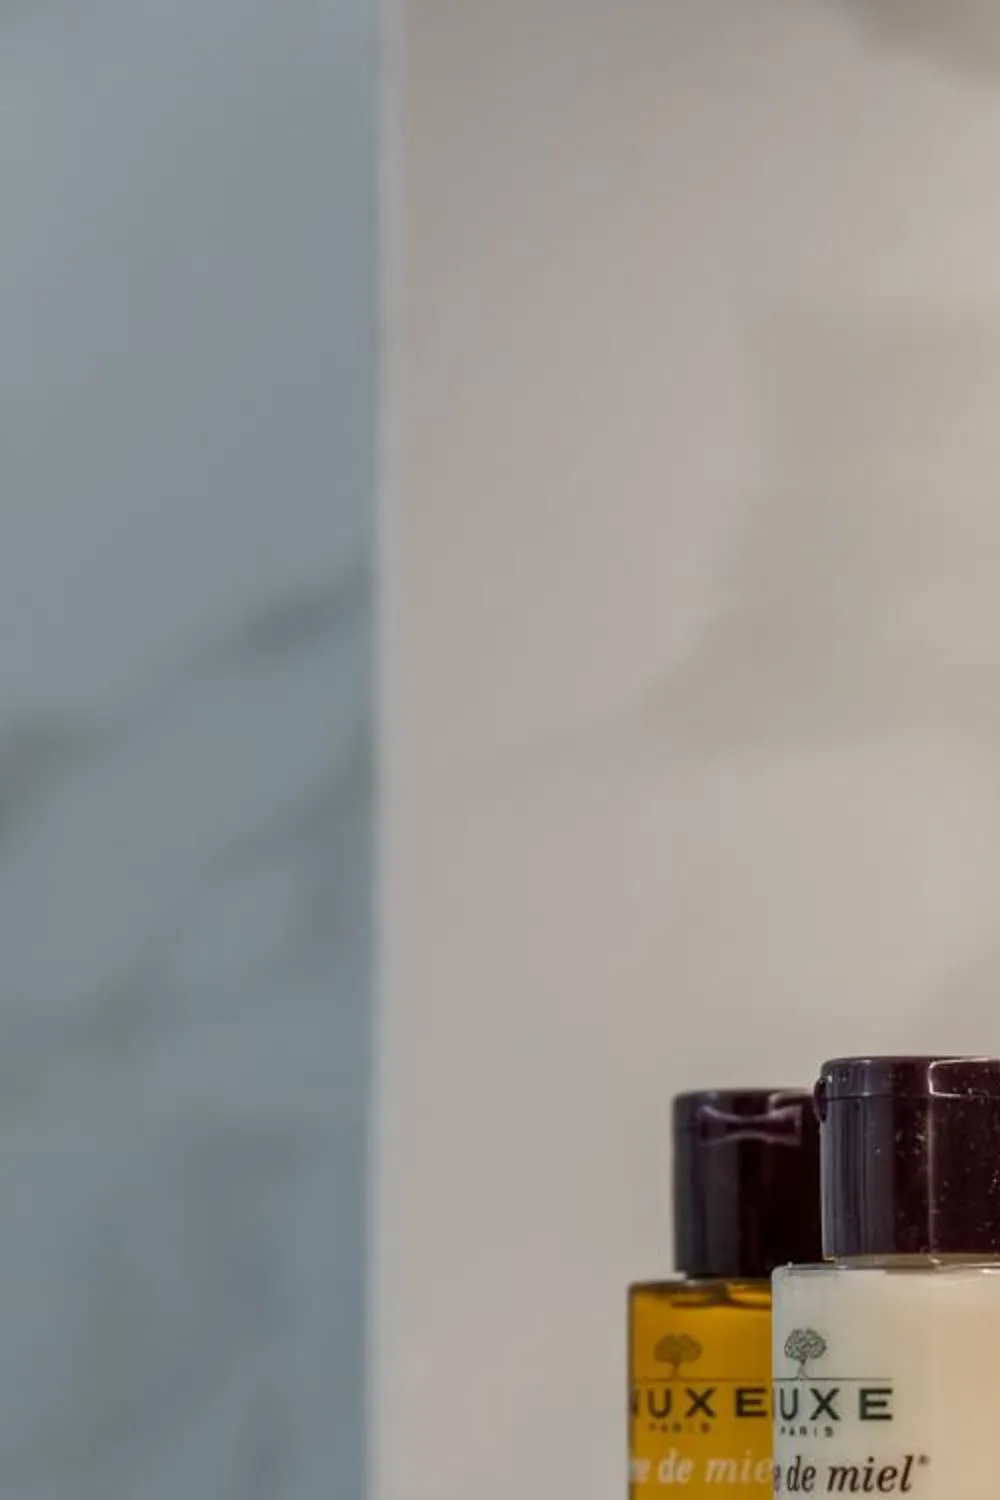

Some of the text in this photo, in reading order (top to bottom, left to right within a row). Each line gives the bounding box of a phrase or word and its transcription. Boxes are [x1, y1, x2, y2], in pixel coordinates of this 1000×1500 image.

[773, 1388, 893, 1421] UXE
[781, 1426, 834, 1437] PARIS
[658, 1448, 693, 1484] de
[704, 1449, 773, 1484] mie
[787, 1455, 816, 1492] de
